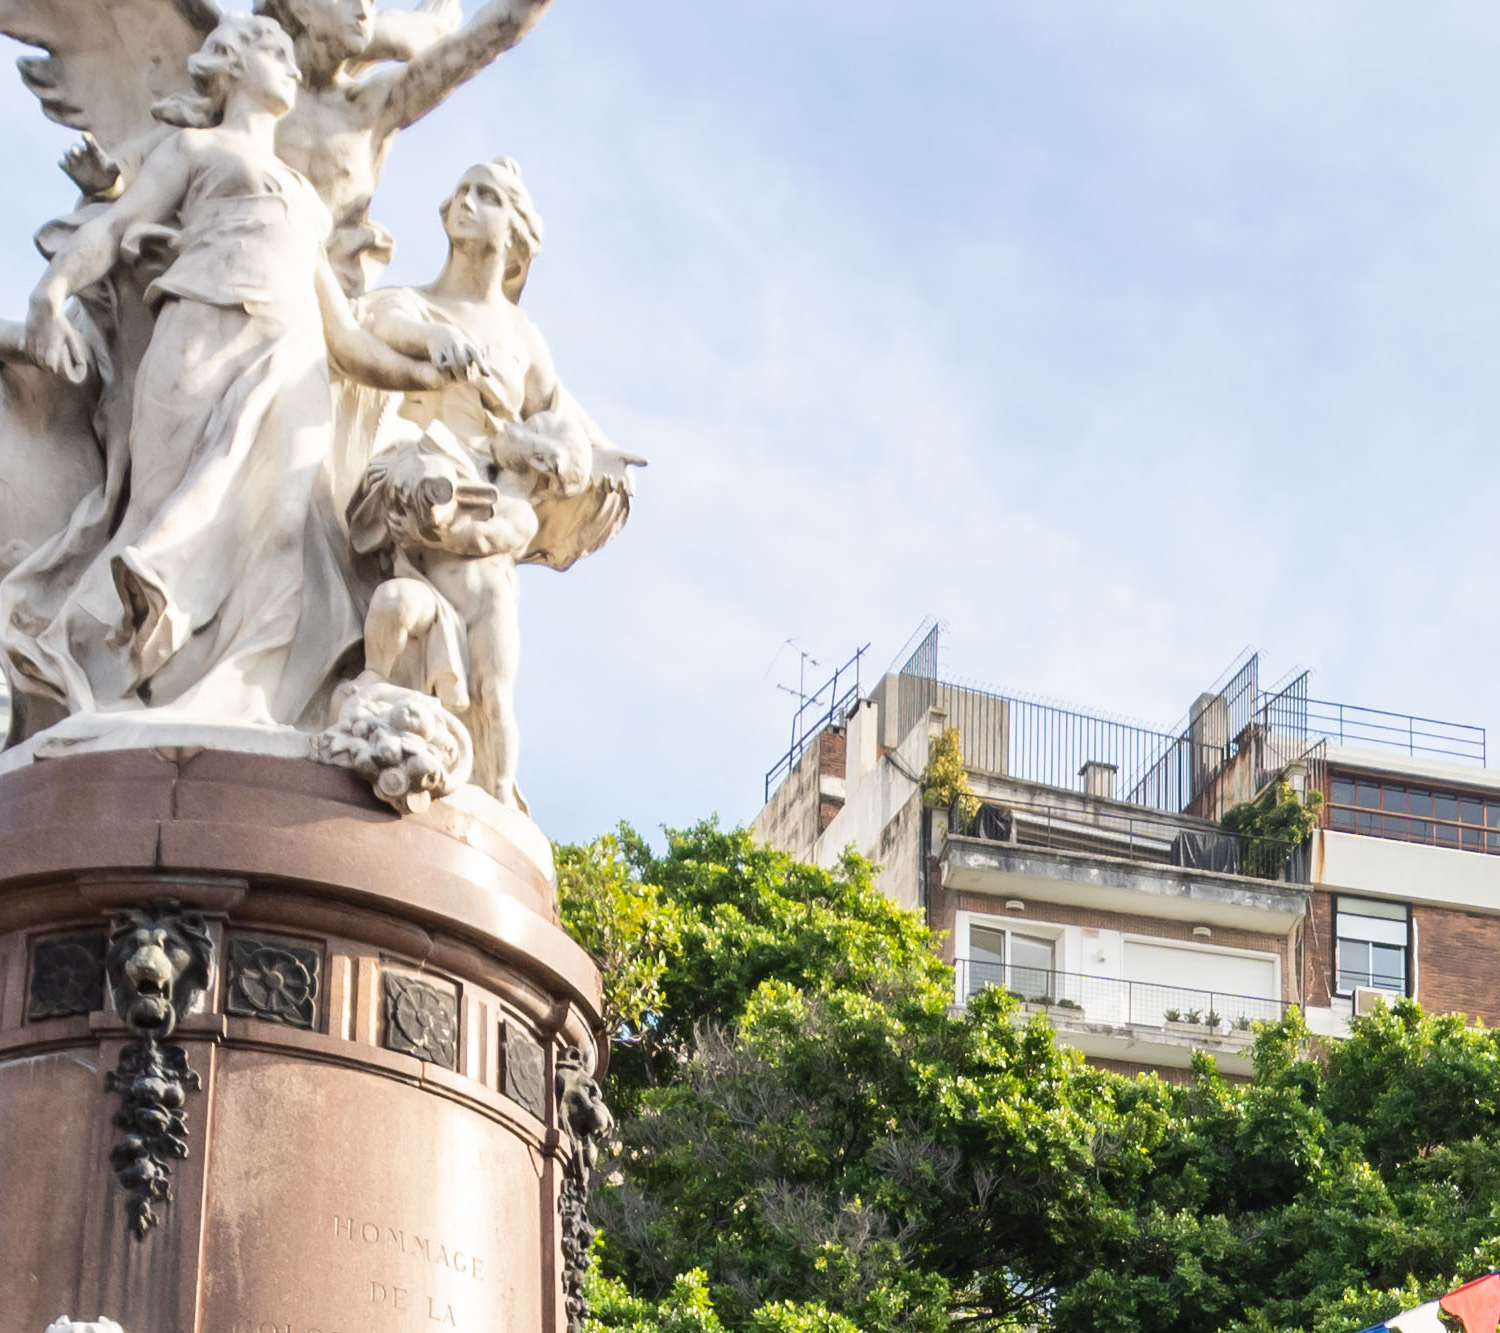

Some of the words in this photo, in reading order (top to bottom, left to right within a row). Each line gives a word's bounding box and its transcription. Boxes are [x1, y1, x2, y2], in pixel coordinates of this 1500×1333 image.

[333, 1214, 485, 1283] HOMMAGE
[370, 1280, 408, 1311] DE
[426, 1296, 457, 1328] LA
